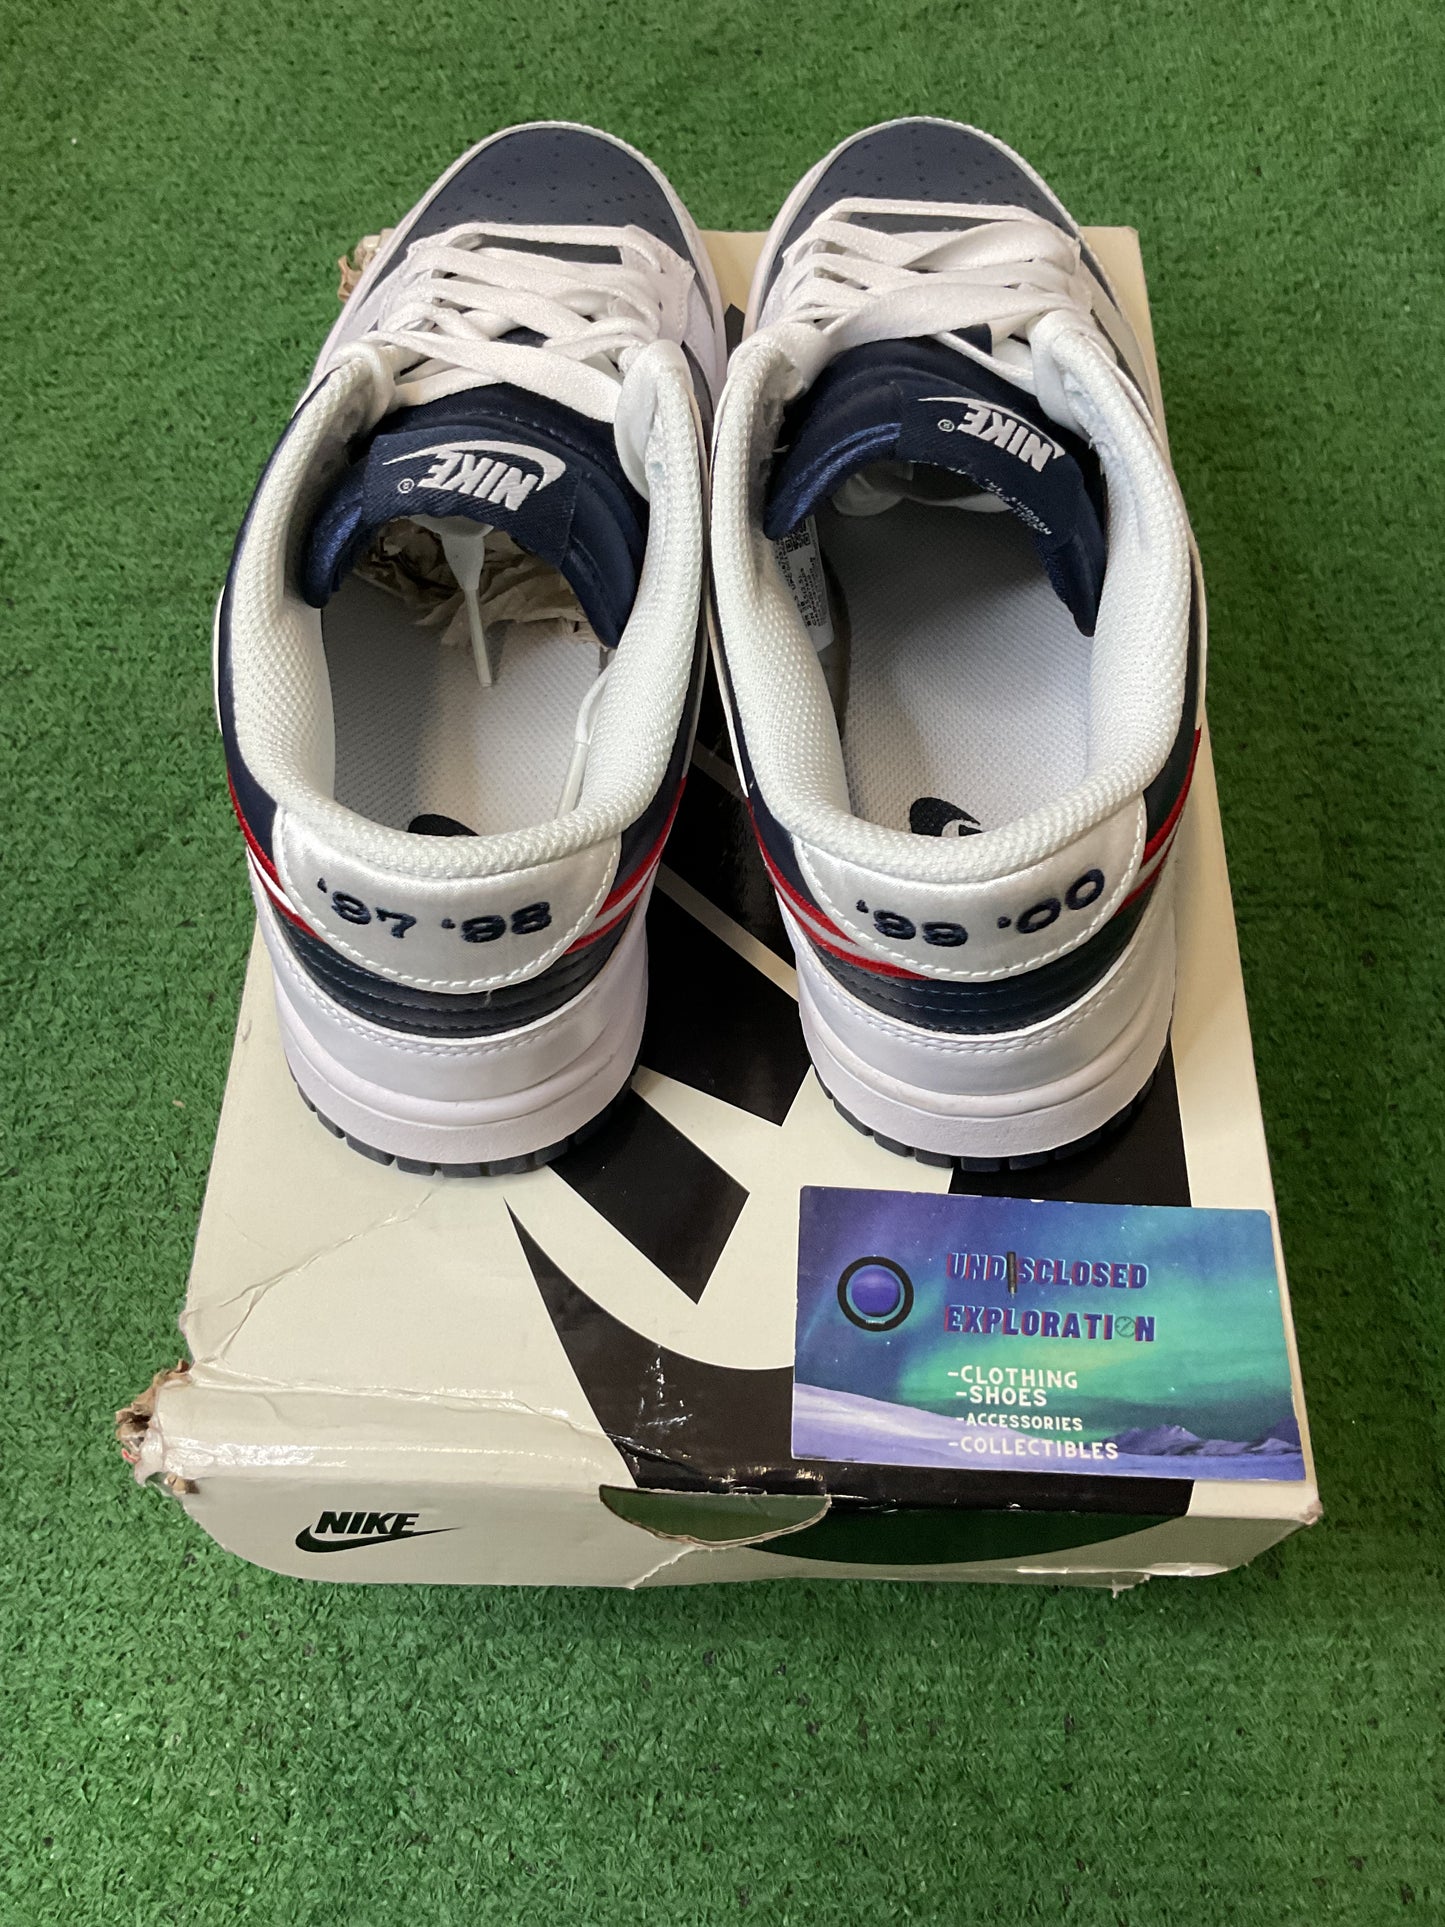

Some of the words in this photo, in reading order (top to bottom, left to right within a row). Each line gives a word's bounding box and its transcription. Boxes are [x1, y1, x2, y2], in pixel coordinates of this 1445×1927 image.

[957, 403, 1053, 472] NIKE
[417, 450, 539, 511] NIKE
[944, 1304, 1155, 1342] EXPLORATION
[947, 1365, 1078, 1389] -CLOTHING
[956, 1385, 1048, 1407] -SHOES
[956, 1412, 1083, 1432] -ACCESSORIES
[948, 1436, 1119, 1460] -COLLECTIBLES
[314, 1511, 420, 1535] NIKE
